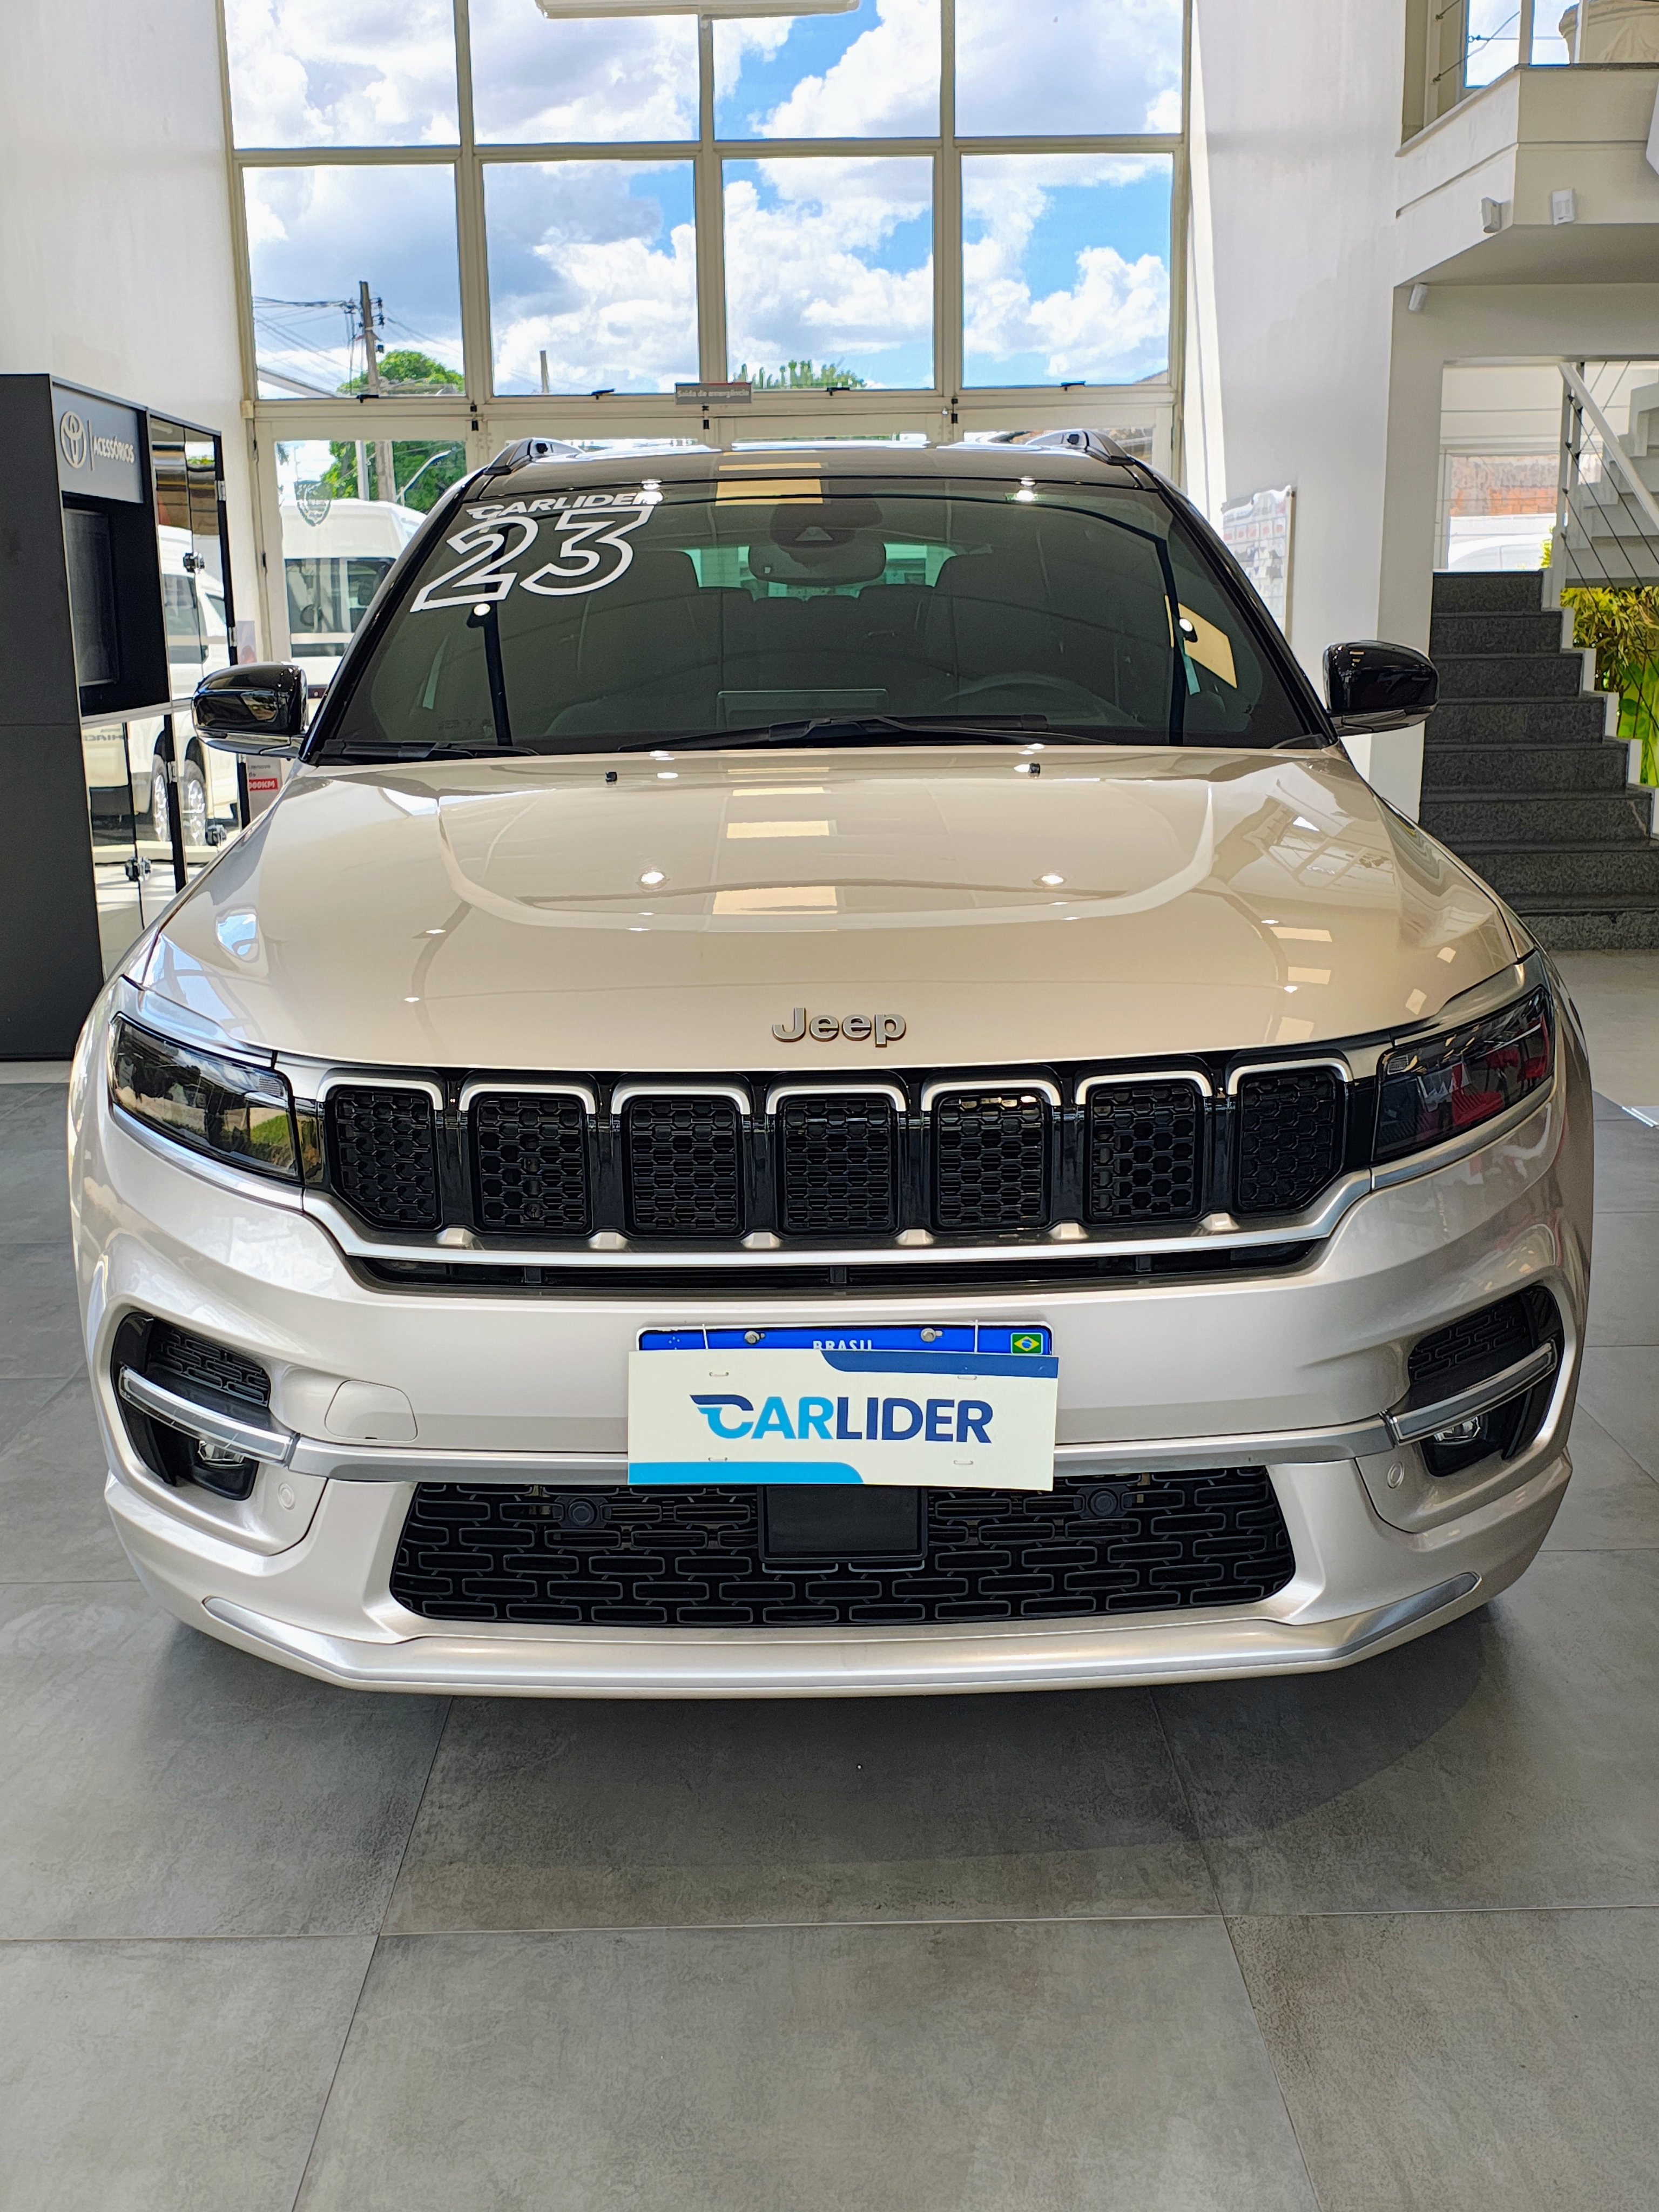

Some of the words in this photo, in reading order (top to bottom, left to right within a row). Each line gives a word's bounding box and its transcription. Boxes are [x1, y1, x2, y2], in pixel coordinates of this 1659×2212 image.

[93, 435, 134, 464] ACESSÓRIOS
[409, 505, 655, 613] 23
[772, 1007, 906, 1048] Jeep
[689, 1394, 993, 1444] CARLIDER
